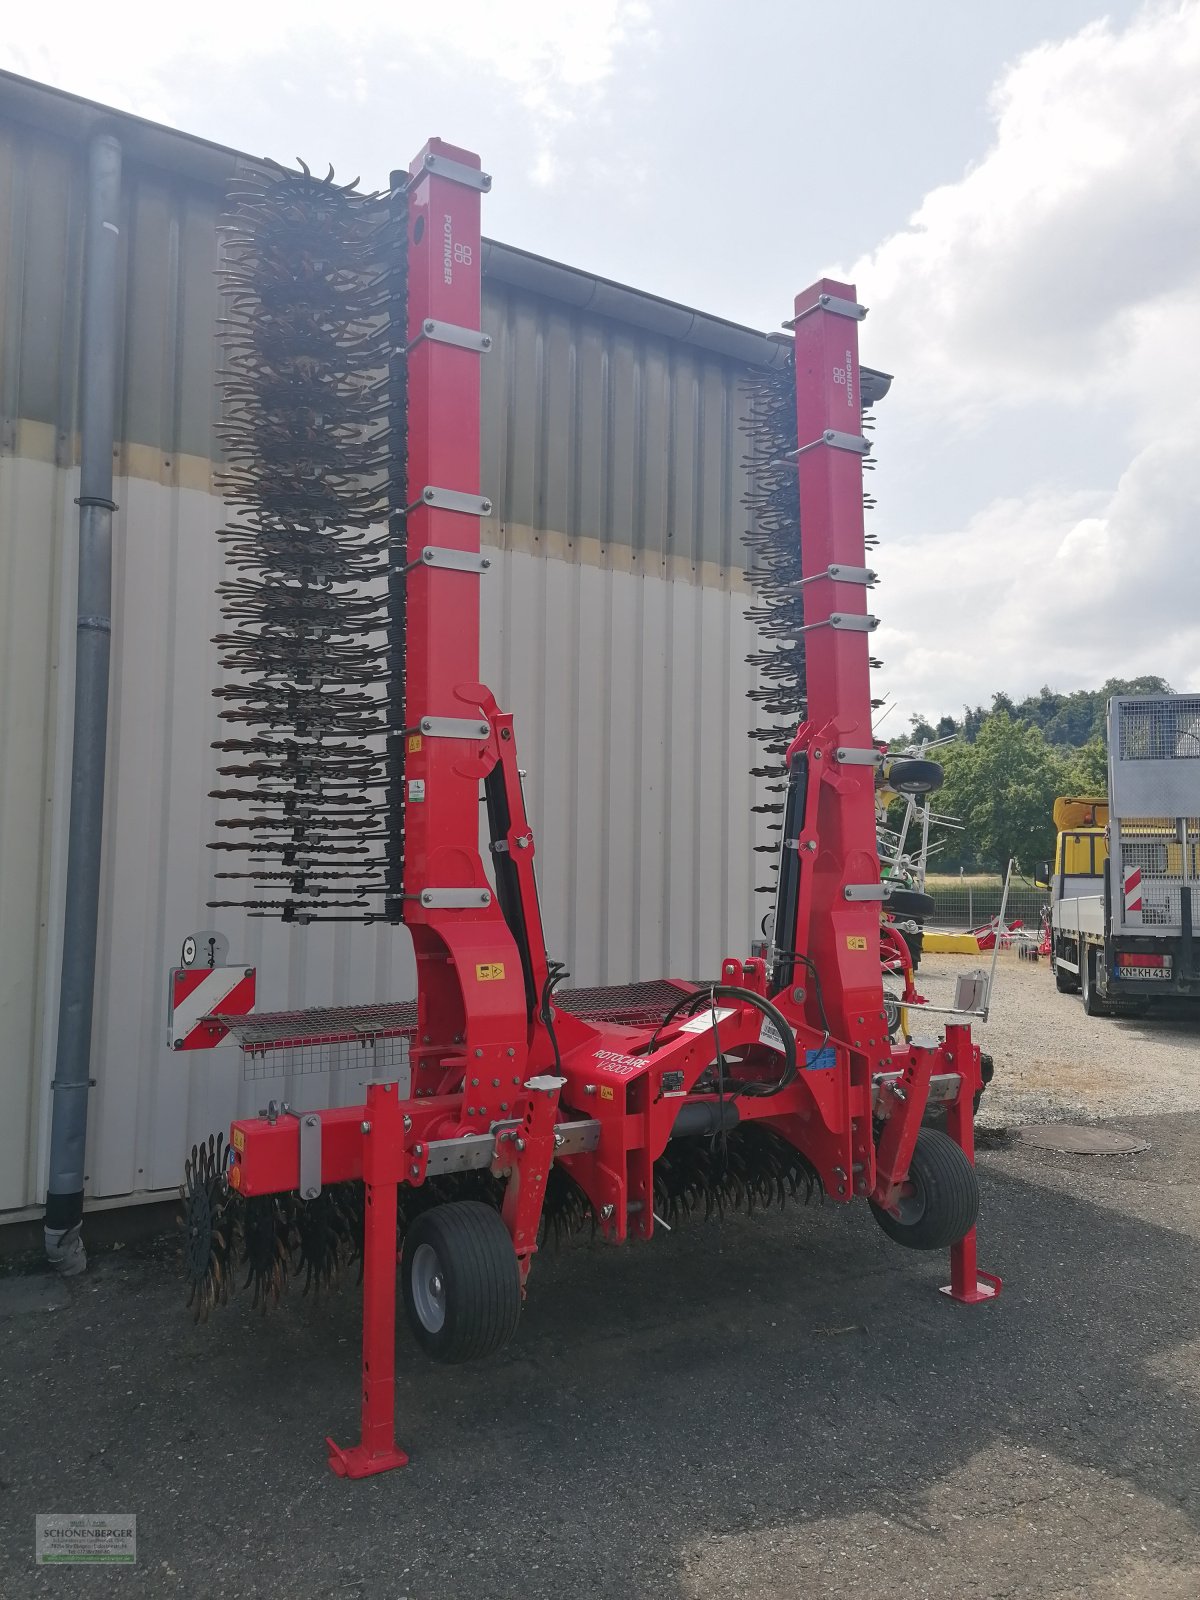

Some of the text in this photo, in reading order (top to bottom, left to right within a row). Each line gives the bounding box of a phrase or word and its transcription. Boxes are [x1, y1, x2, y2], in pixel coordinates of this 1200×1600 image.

[1119, 968, 1171, 978] KN KH 413
[592, 1049, 650, 1068] ROTOCARE
[603, 1061, 634, 1075] 8000
